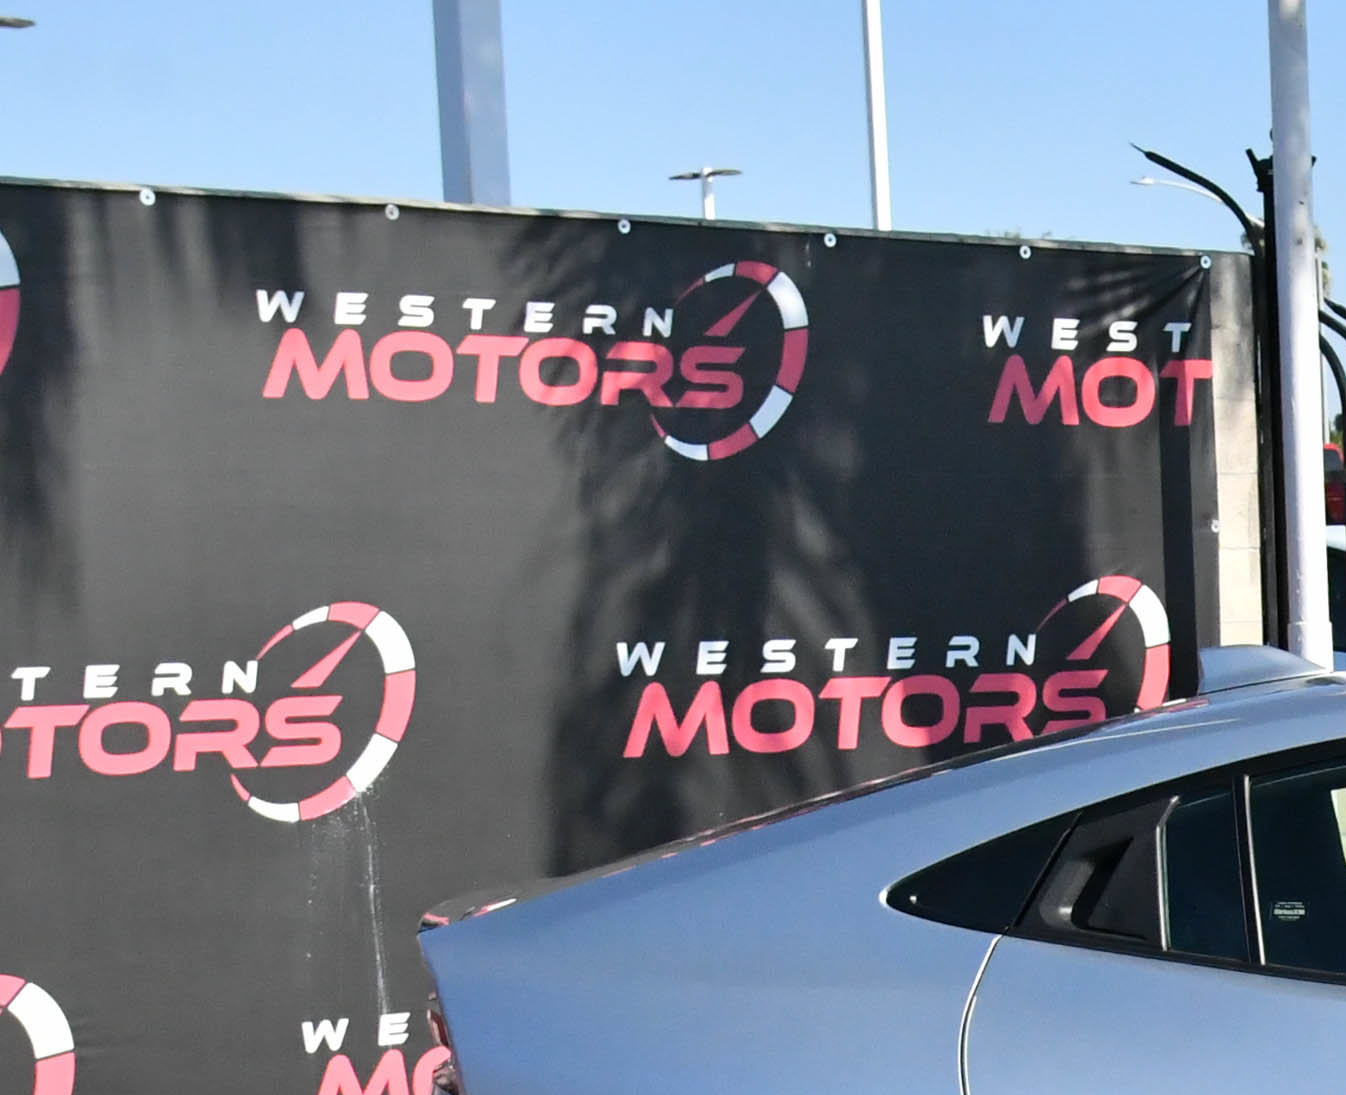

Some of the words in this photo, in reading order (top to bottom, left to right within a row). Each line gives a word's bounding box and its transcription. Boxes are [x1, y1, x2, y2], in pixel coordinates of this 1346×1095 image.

[256, 289, 673, 337] WESTERN
[983, 315, 1191, 352] WEST
[262, 328, 745, 408] MOTORS
[988, 354, 1213, 428] MOT
[10, 660, 259, 702] TERN
[616, 634, 1036, 676] WESTERN
[0, 695, 343, 778] TORS
[623, 669, 1108, 758] MOTORS
